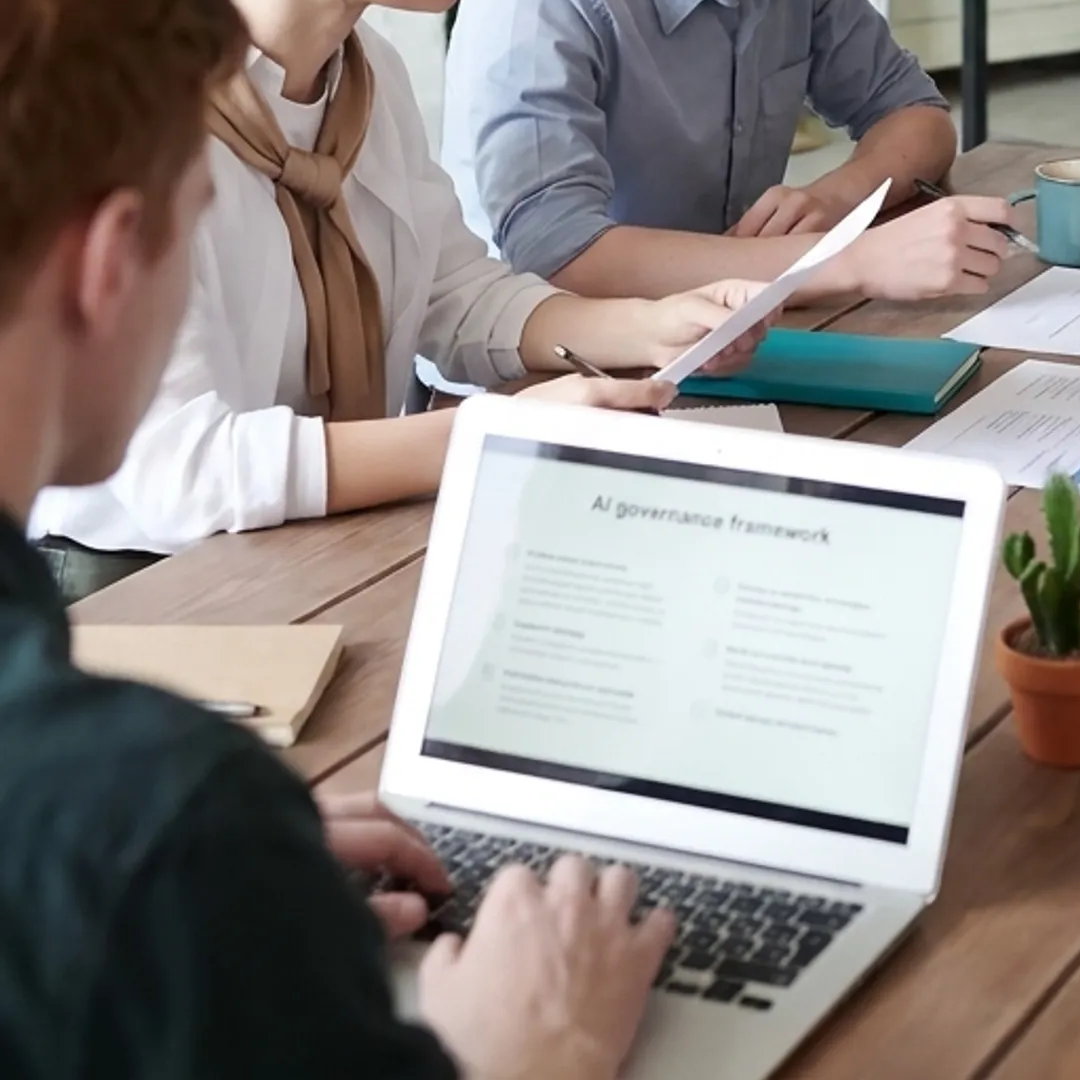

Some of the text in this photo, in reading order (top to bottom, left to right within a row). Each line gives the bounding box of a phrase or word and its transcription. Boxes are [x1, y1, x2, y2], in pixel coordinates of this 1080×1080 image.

[591, 495, 830, 545] AI governance framework
